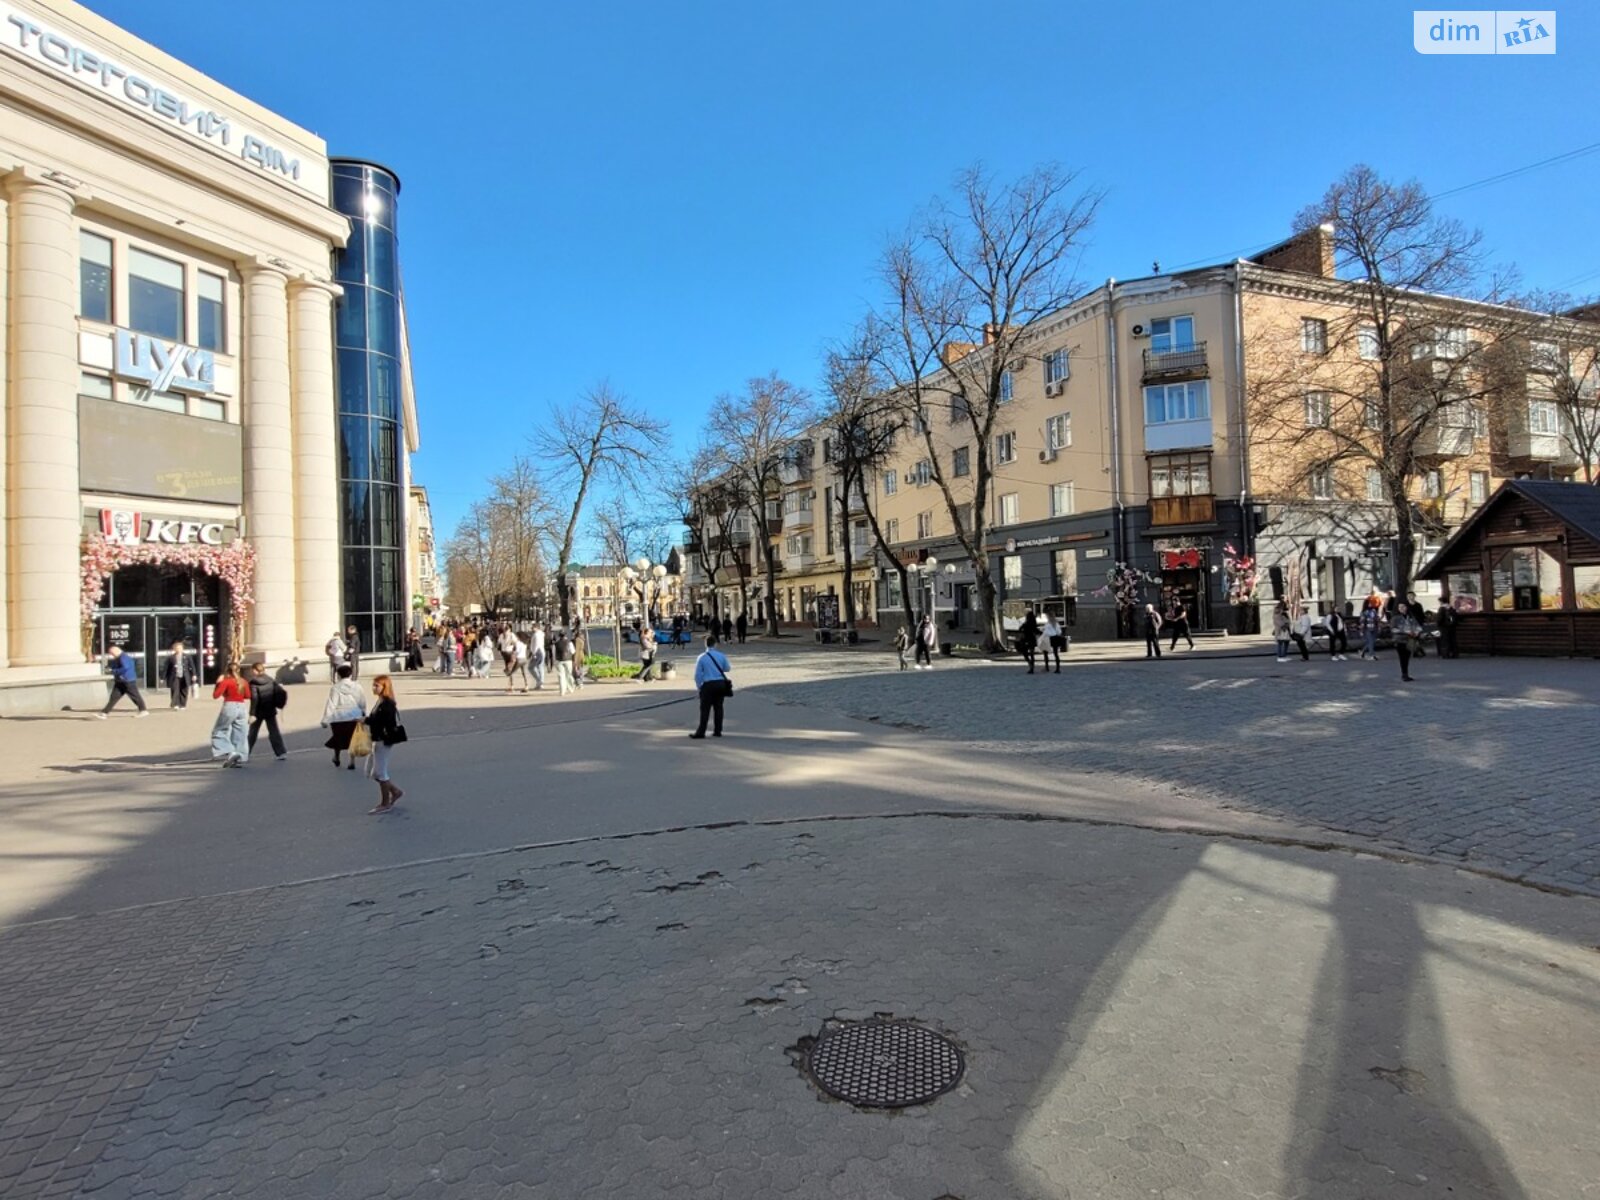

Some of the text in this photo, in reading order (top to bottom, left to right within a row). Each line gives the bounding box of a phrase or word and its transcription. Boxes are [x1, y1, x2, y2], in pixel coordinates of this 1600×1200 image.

[8, 14, 301, 181] ТОРГОВИЙ ДІМ
[145, 519, 224, 545] KFC
